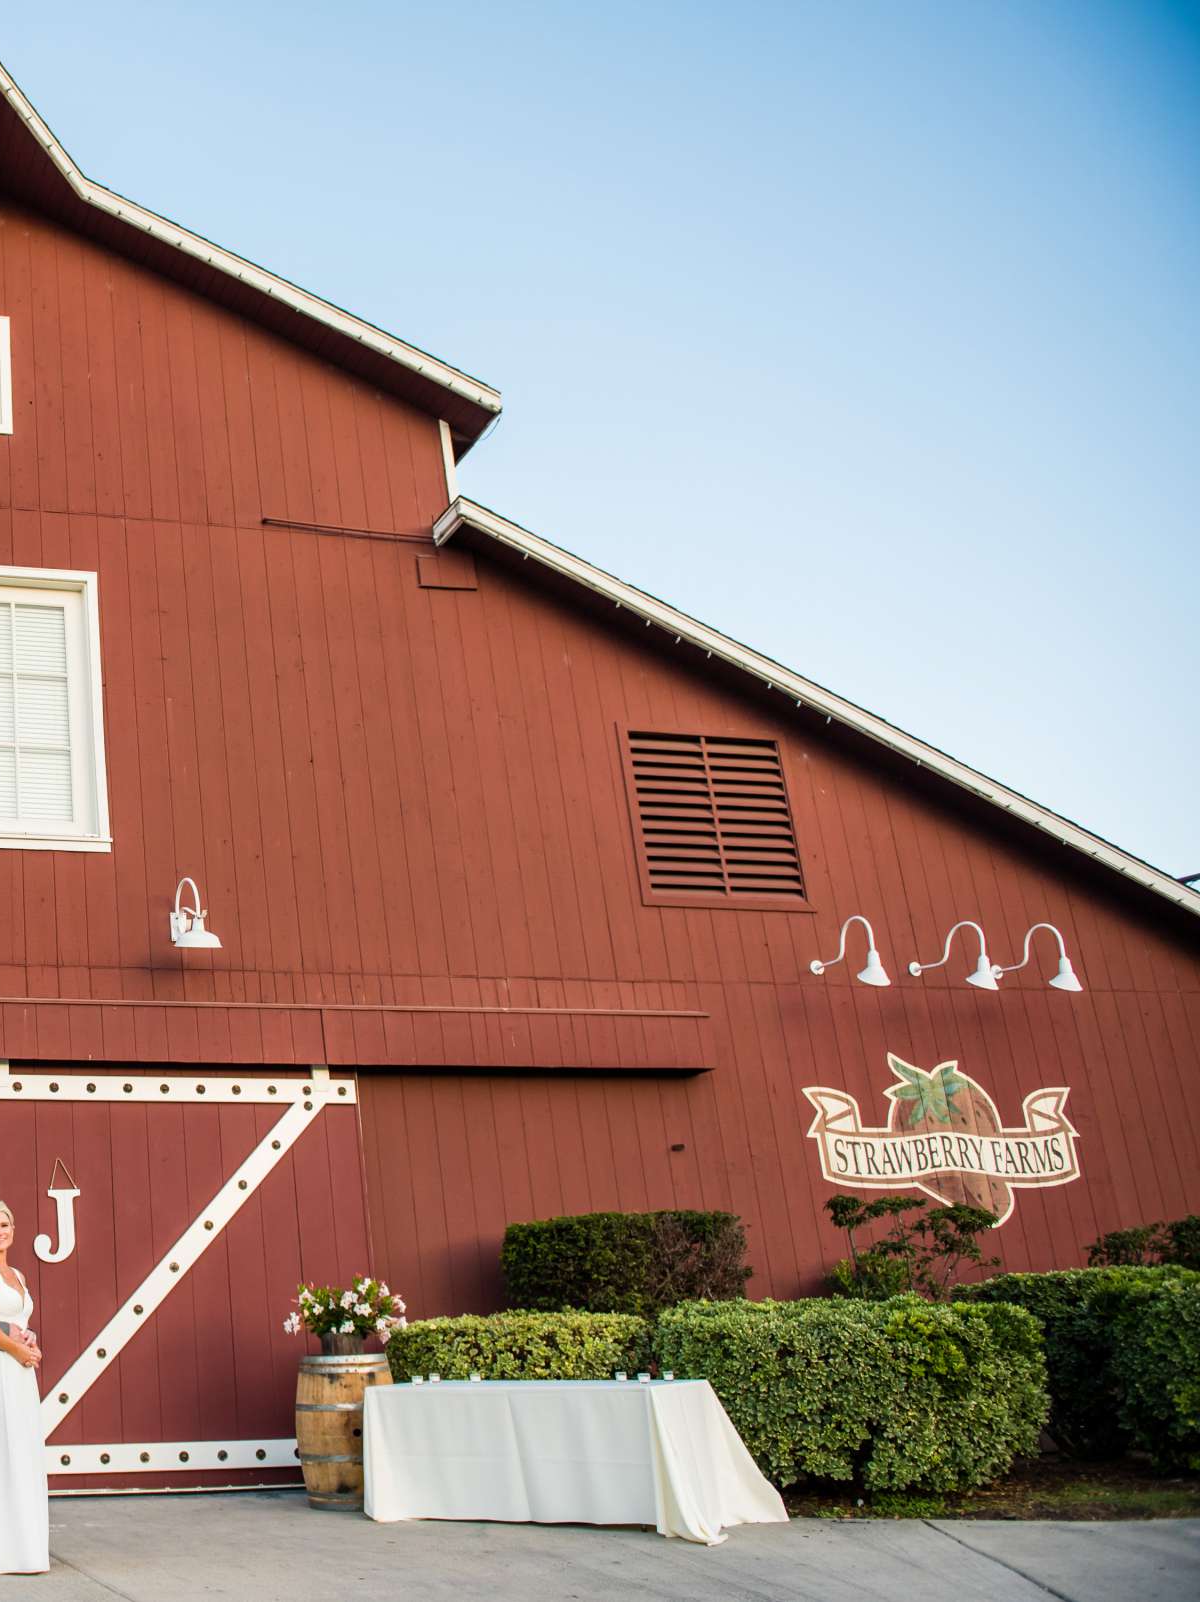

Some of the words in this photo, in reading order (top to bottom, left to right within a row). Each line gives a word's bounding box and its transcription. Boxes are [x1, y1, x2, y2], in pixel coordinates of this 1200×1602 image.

[833, 1135, 986, 1175] STRAWBERRY
[991, 1136, 1065, 1174] FARMS
[33, 1188, 81, 1264] J
